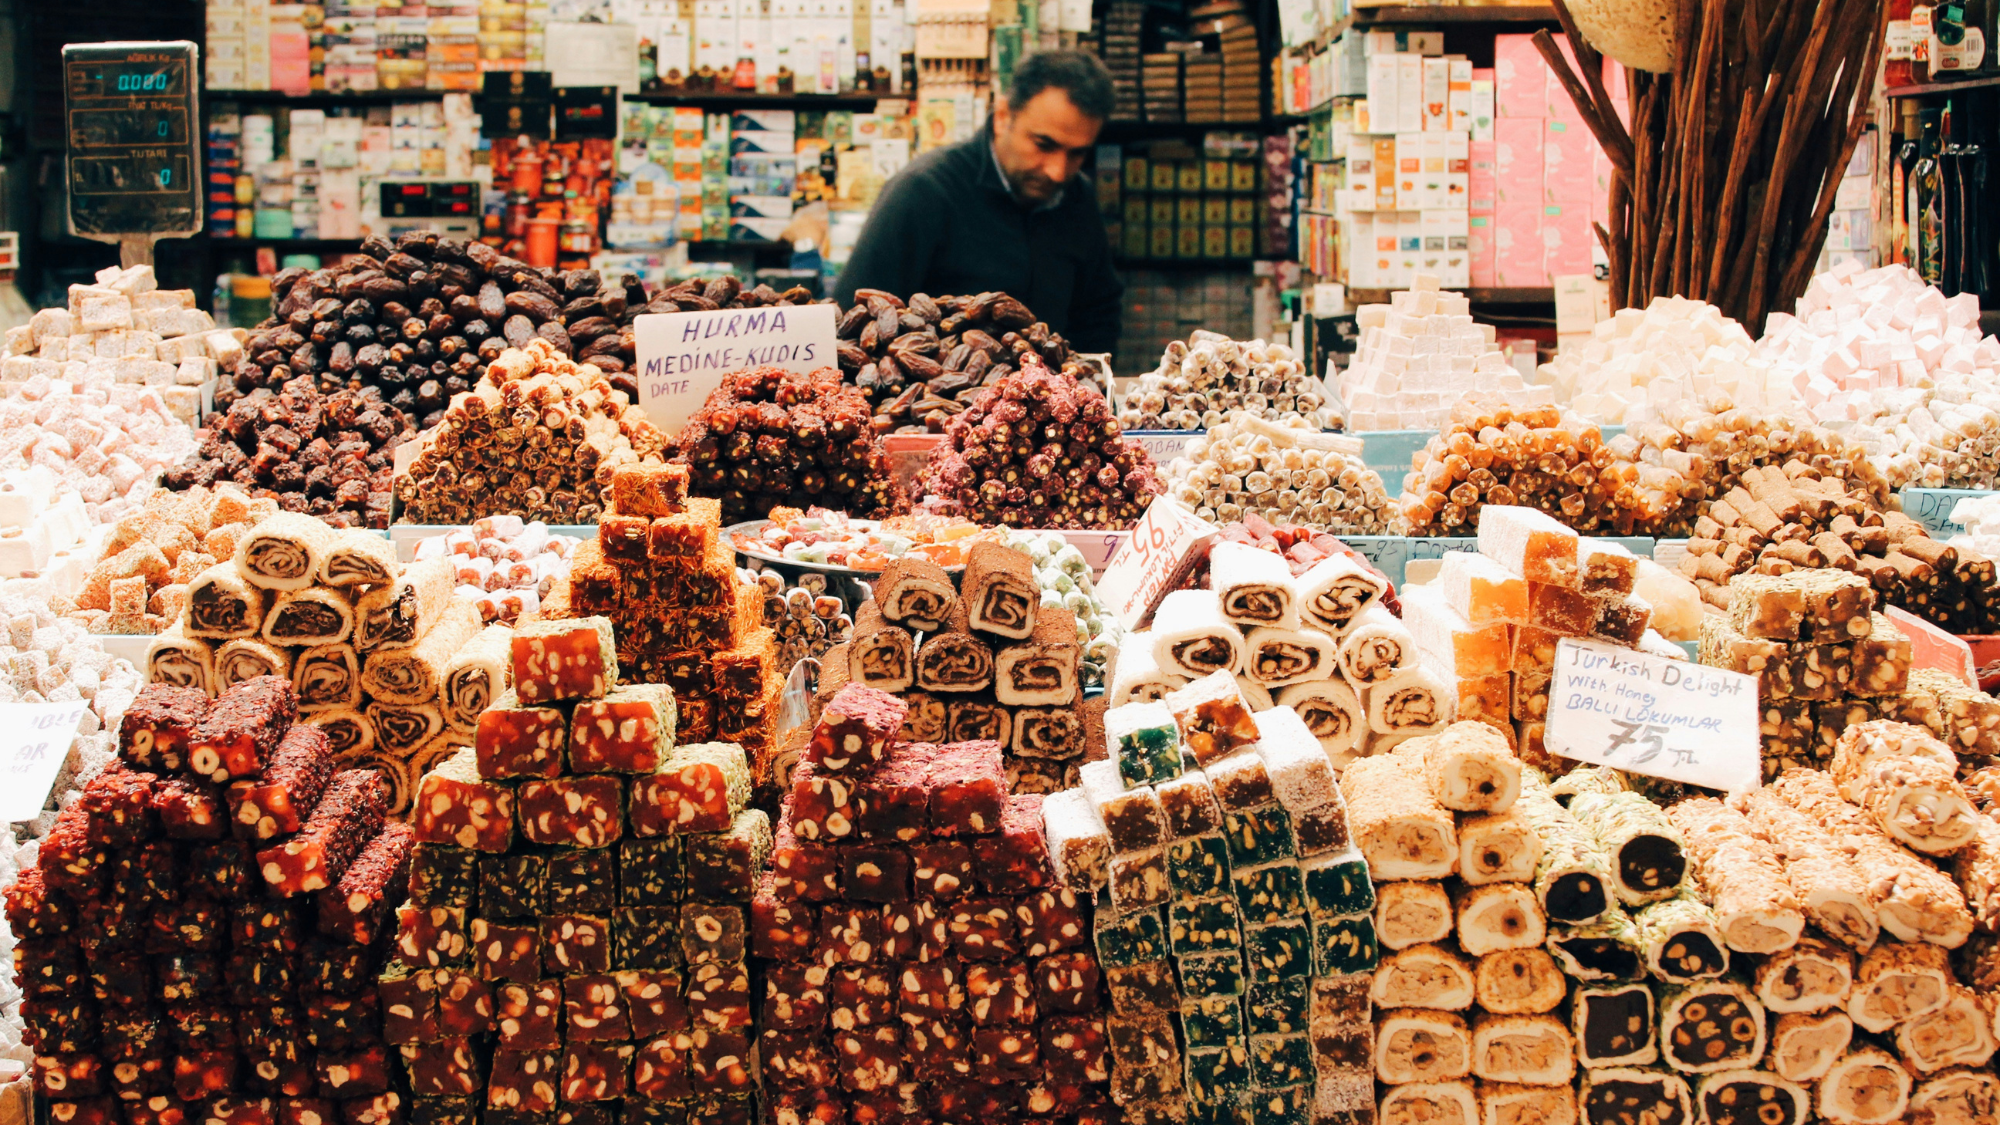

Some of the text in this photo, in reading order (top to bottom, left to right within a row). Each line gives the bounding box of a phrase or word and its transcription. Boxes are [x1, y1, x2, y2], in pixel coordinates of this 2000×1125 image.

[157, 120, 168, 136] 0
[160, 169, 171, 185] 0
[682, 311, 786, 343] HURMA
[651, 380, 690, 398] DATE
[1132, 506, 1165, 568] 95
[1144, 550, 1178, 607] ANTEP
[1564, 643, 1743, 697] Turkish Delight
[1567, 675, 1657, 707] With Honey
[1566, 694, 1723, 733] BALLI LOKUMLAR
[1603, 718, 1670, 764] 75
